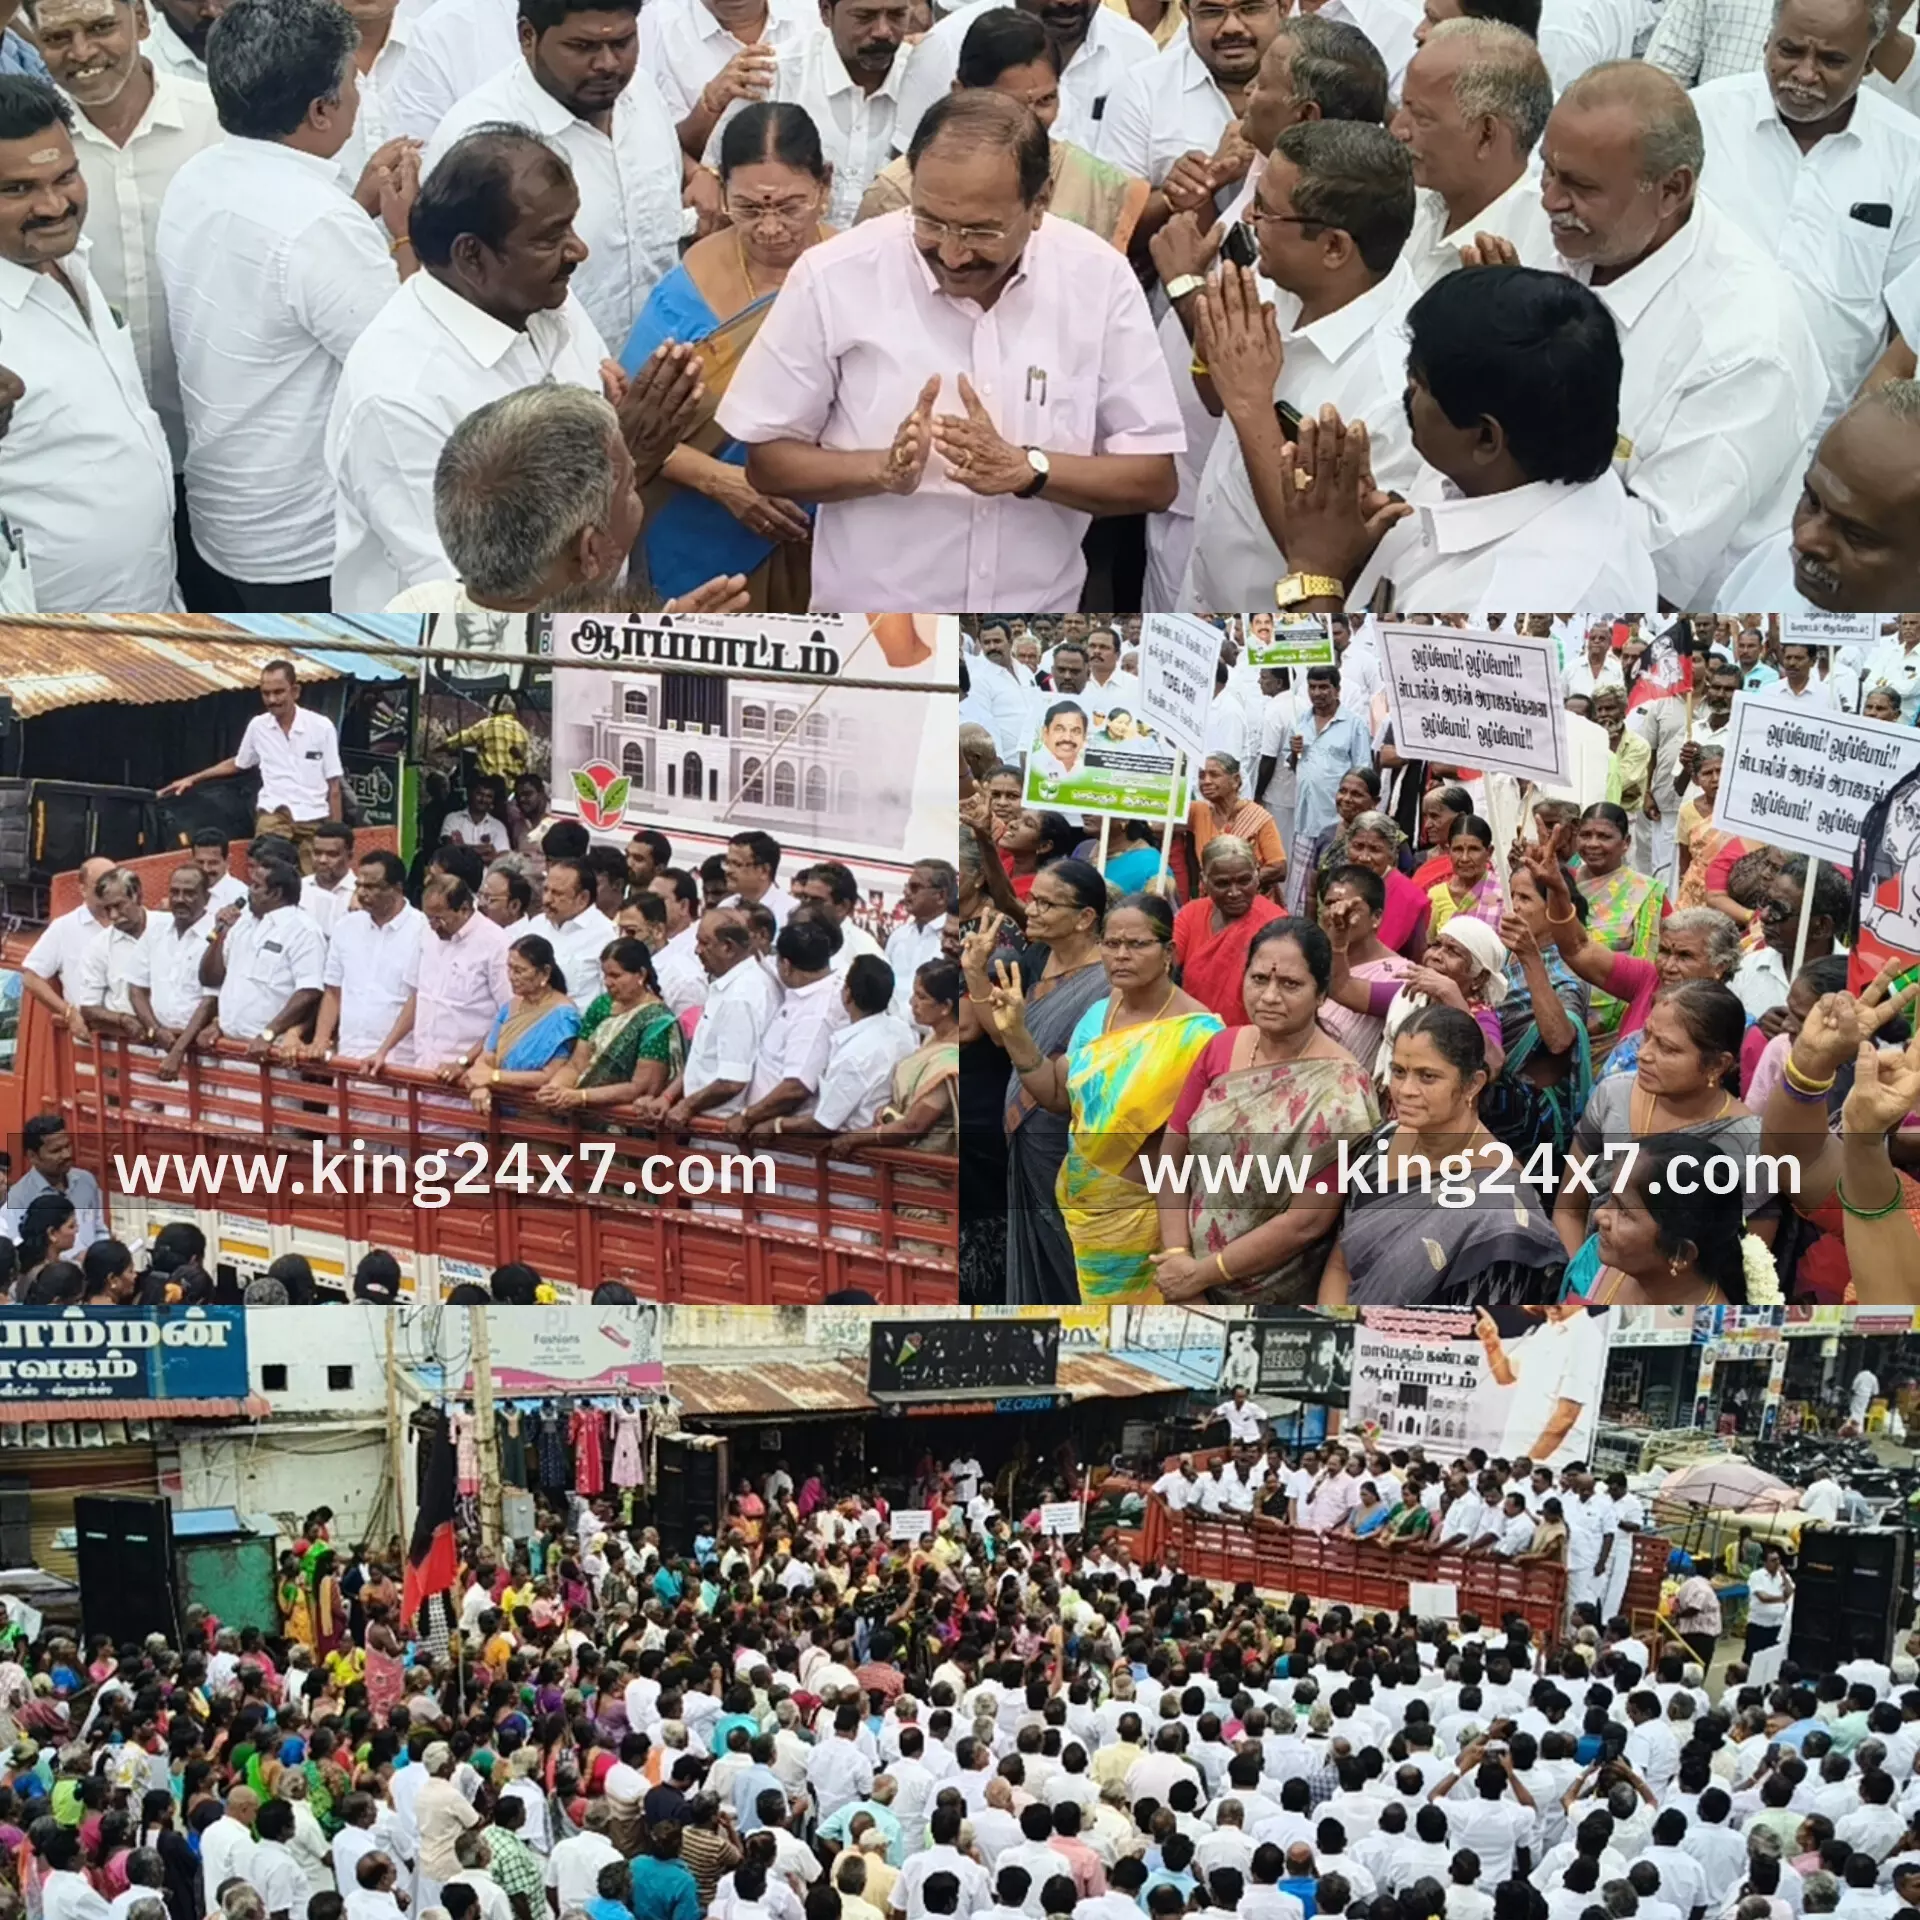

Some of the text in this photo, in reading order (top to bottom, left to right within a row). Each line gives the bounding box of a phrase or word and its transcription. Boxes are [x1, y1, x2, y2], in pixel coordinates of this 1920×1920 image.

[1412, 643, 1523, 679] ஒழிப்போம்! ஒழிப்போம்!!
[1767, 721, 1901, 770] ஒழிப்போம்! ஒழிப்போம்!!
[533, 1333, 580, 1345] Fashions
